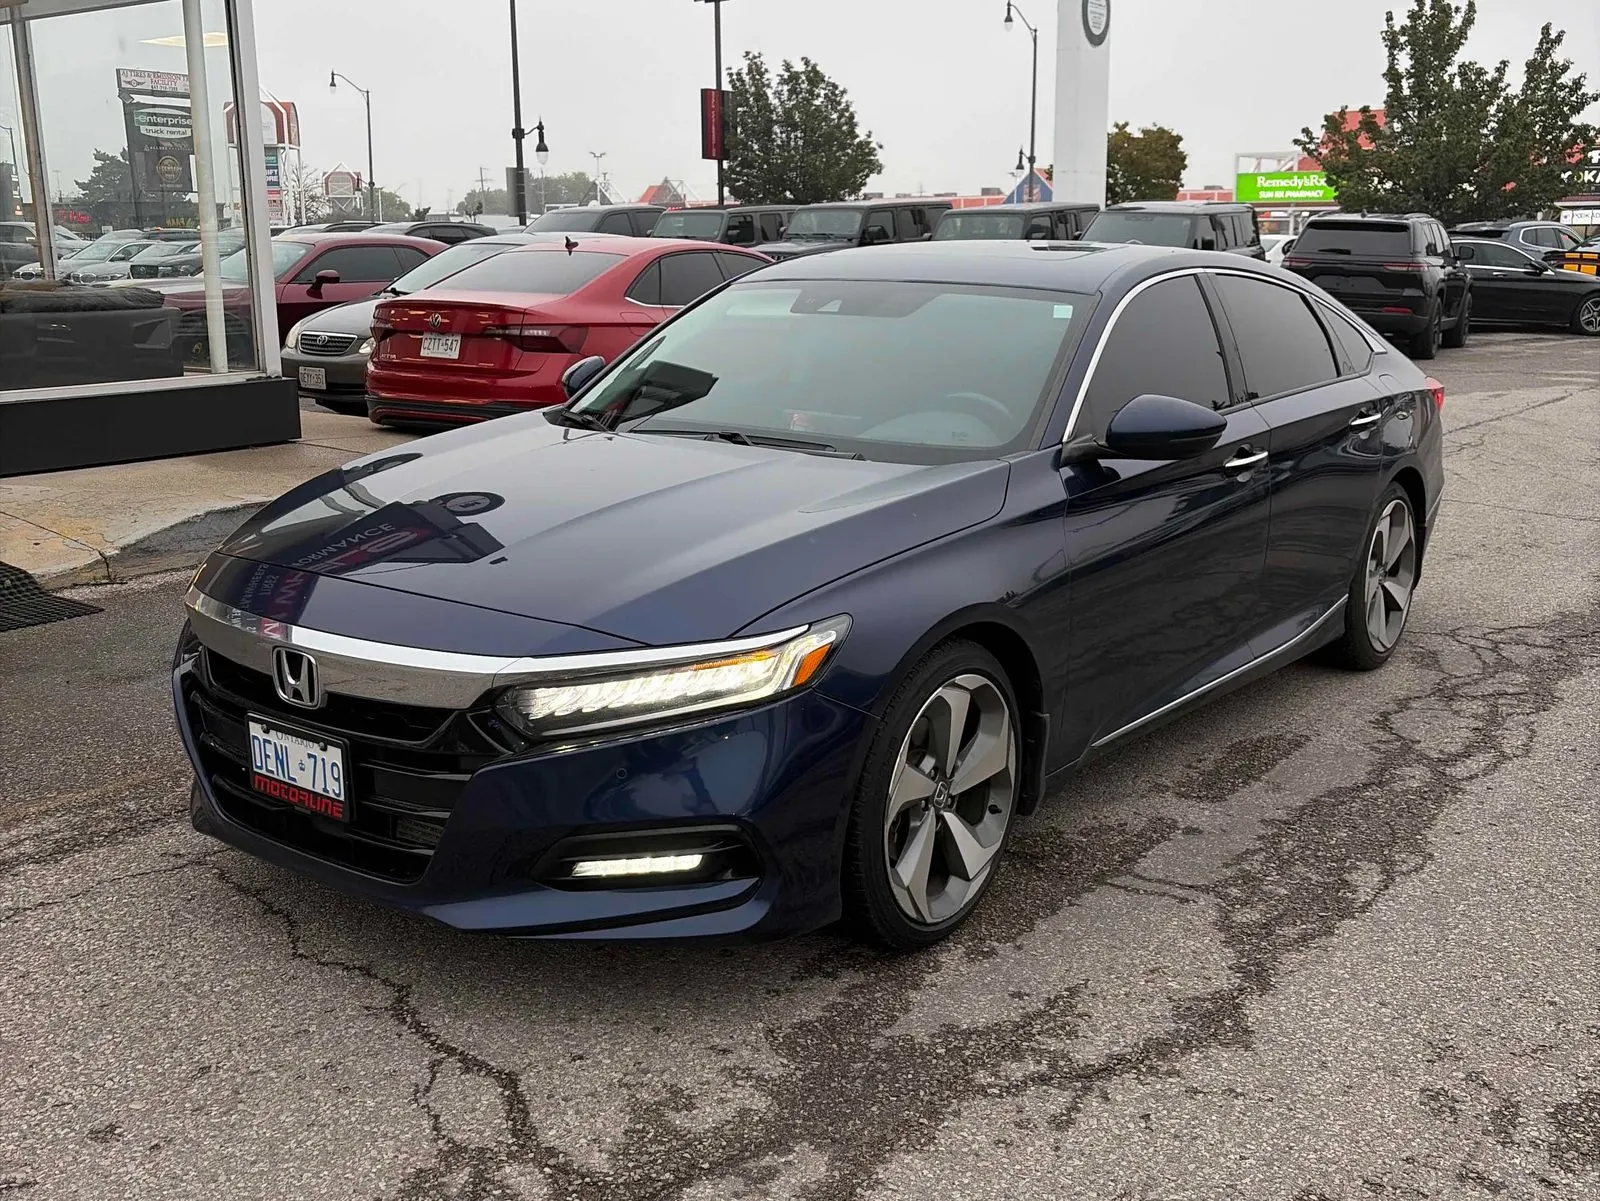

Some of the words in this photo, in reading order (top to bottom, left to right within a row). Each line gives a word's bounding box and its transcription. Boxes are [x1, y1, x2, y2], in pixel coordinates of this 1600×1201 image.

[151, 79, 177, 87] FACILITY
[139, 114, 192, 126] enterprise
[1284, 189, 1324, 198] PHARMACY
